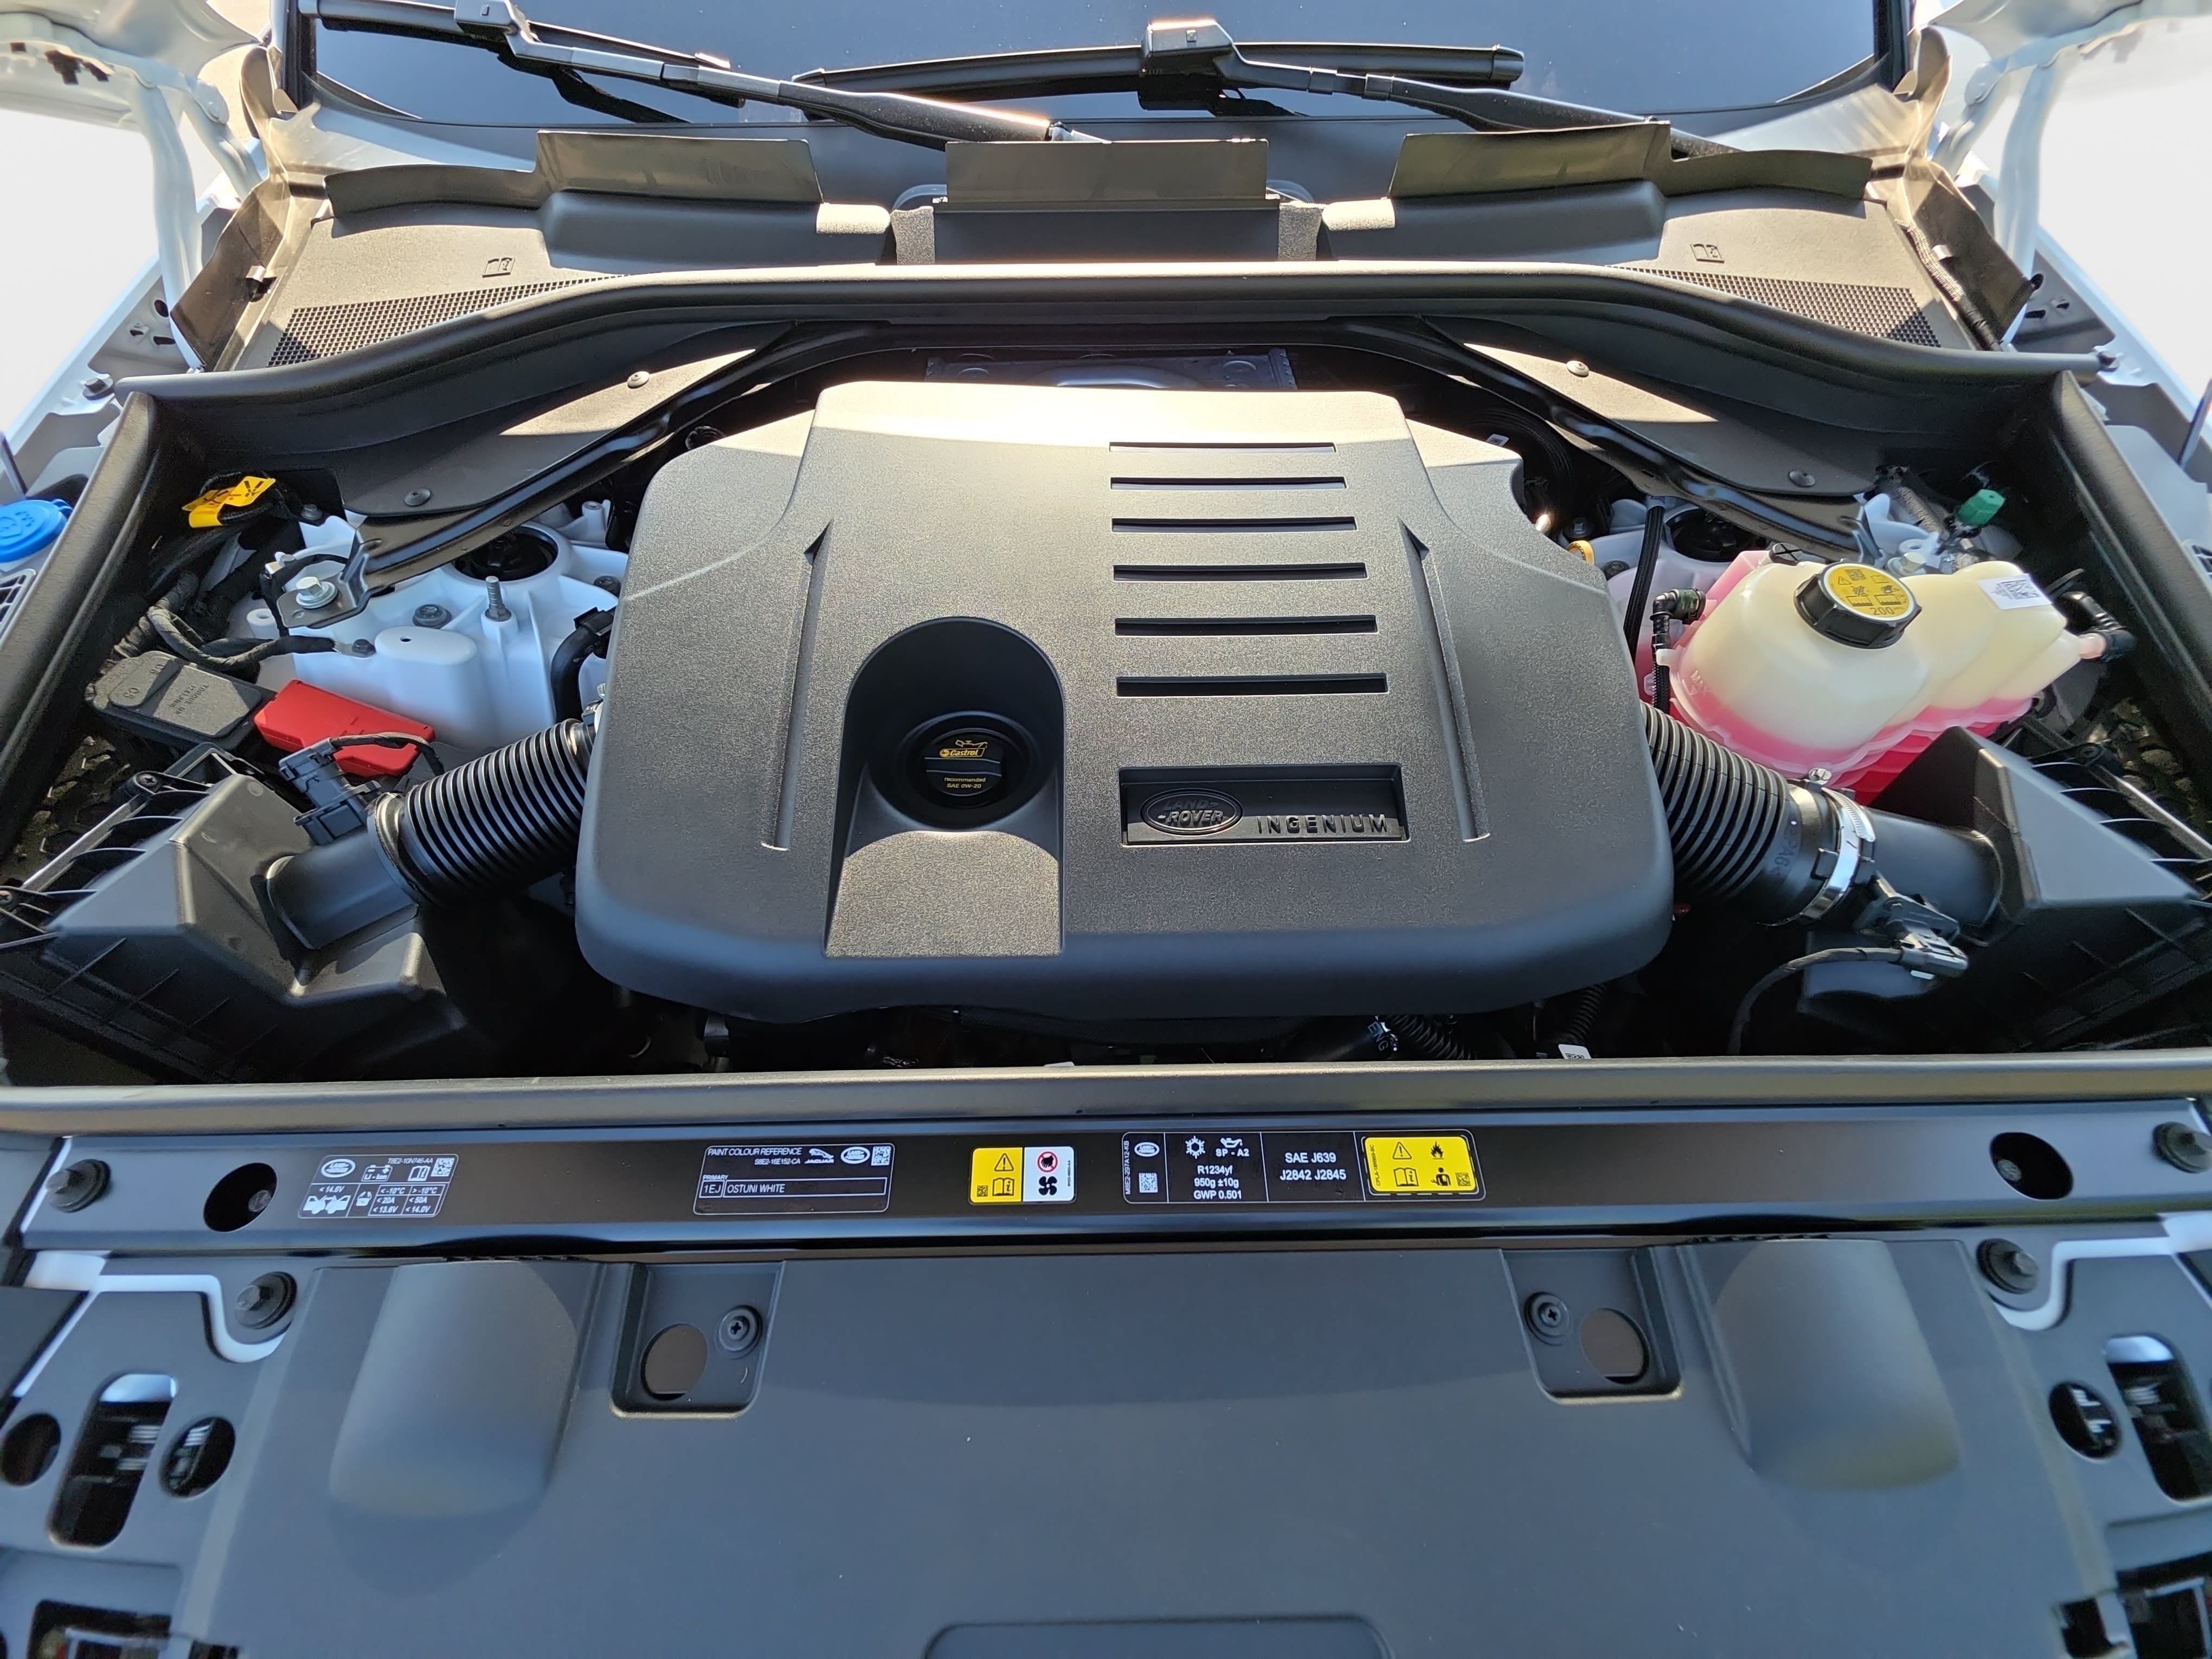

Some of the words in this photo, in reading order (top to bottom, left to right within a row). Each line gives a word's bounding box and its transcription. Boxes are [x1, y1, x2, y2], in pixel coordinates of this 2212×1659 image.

[1870, 607, 1895, 615] 200
[1163, 799, 1208, 811] LAND
[1167, 810, 1224, 824] ROVER
[1256, 814, 1387, 834] INGENIUM
[1367, 1021, 1388, 1051] ENG
[1216, 1148, 1228, 1157] SP
[1237, 1148, 1250, 1156] A2
[1285, 1152, 1309, 1163] SAE
[1311, 1152, 1336, 1163] J639
[1197, 1165, 1233, 1176] R1234yf
[1279, 1169, 1312, 1180] J2842
[1314, 1169, 1347, 1180] J2845
[704, 1184, 721, 1193] 1EJ
[727, 1184, 758, 1193] OSTUNI
[760, 1184, 786, 1193] WHITE
[1194, 1178, 1216, 1188] 950g
[1218, 1178, 1239, 1188] ±10g
[1194, 1190, 1217, 1199] GWP
[1218, 1190, 1242, 1199] 0.501
